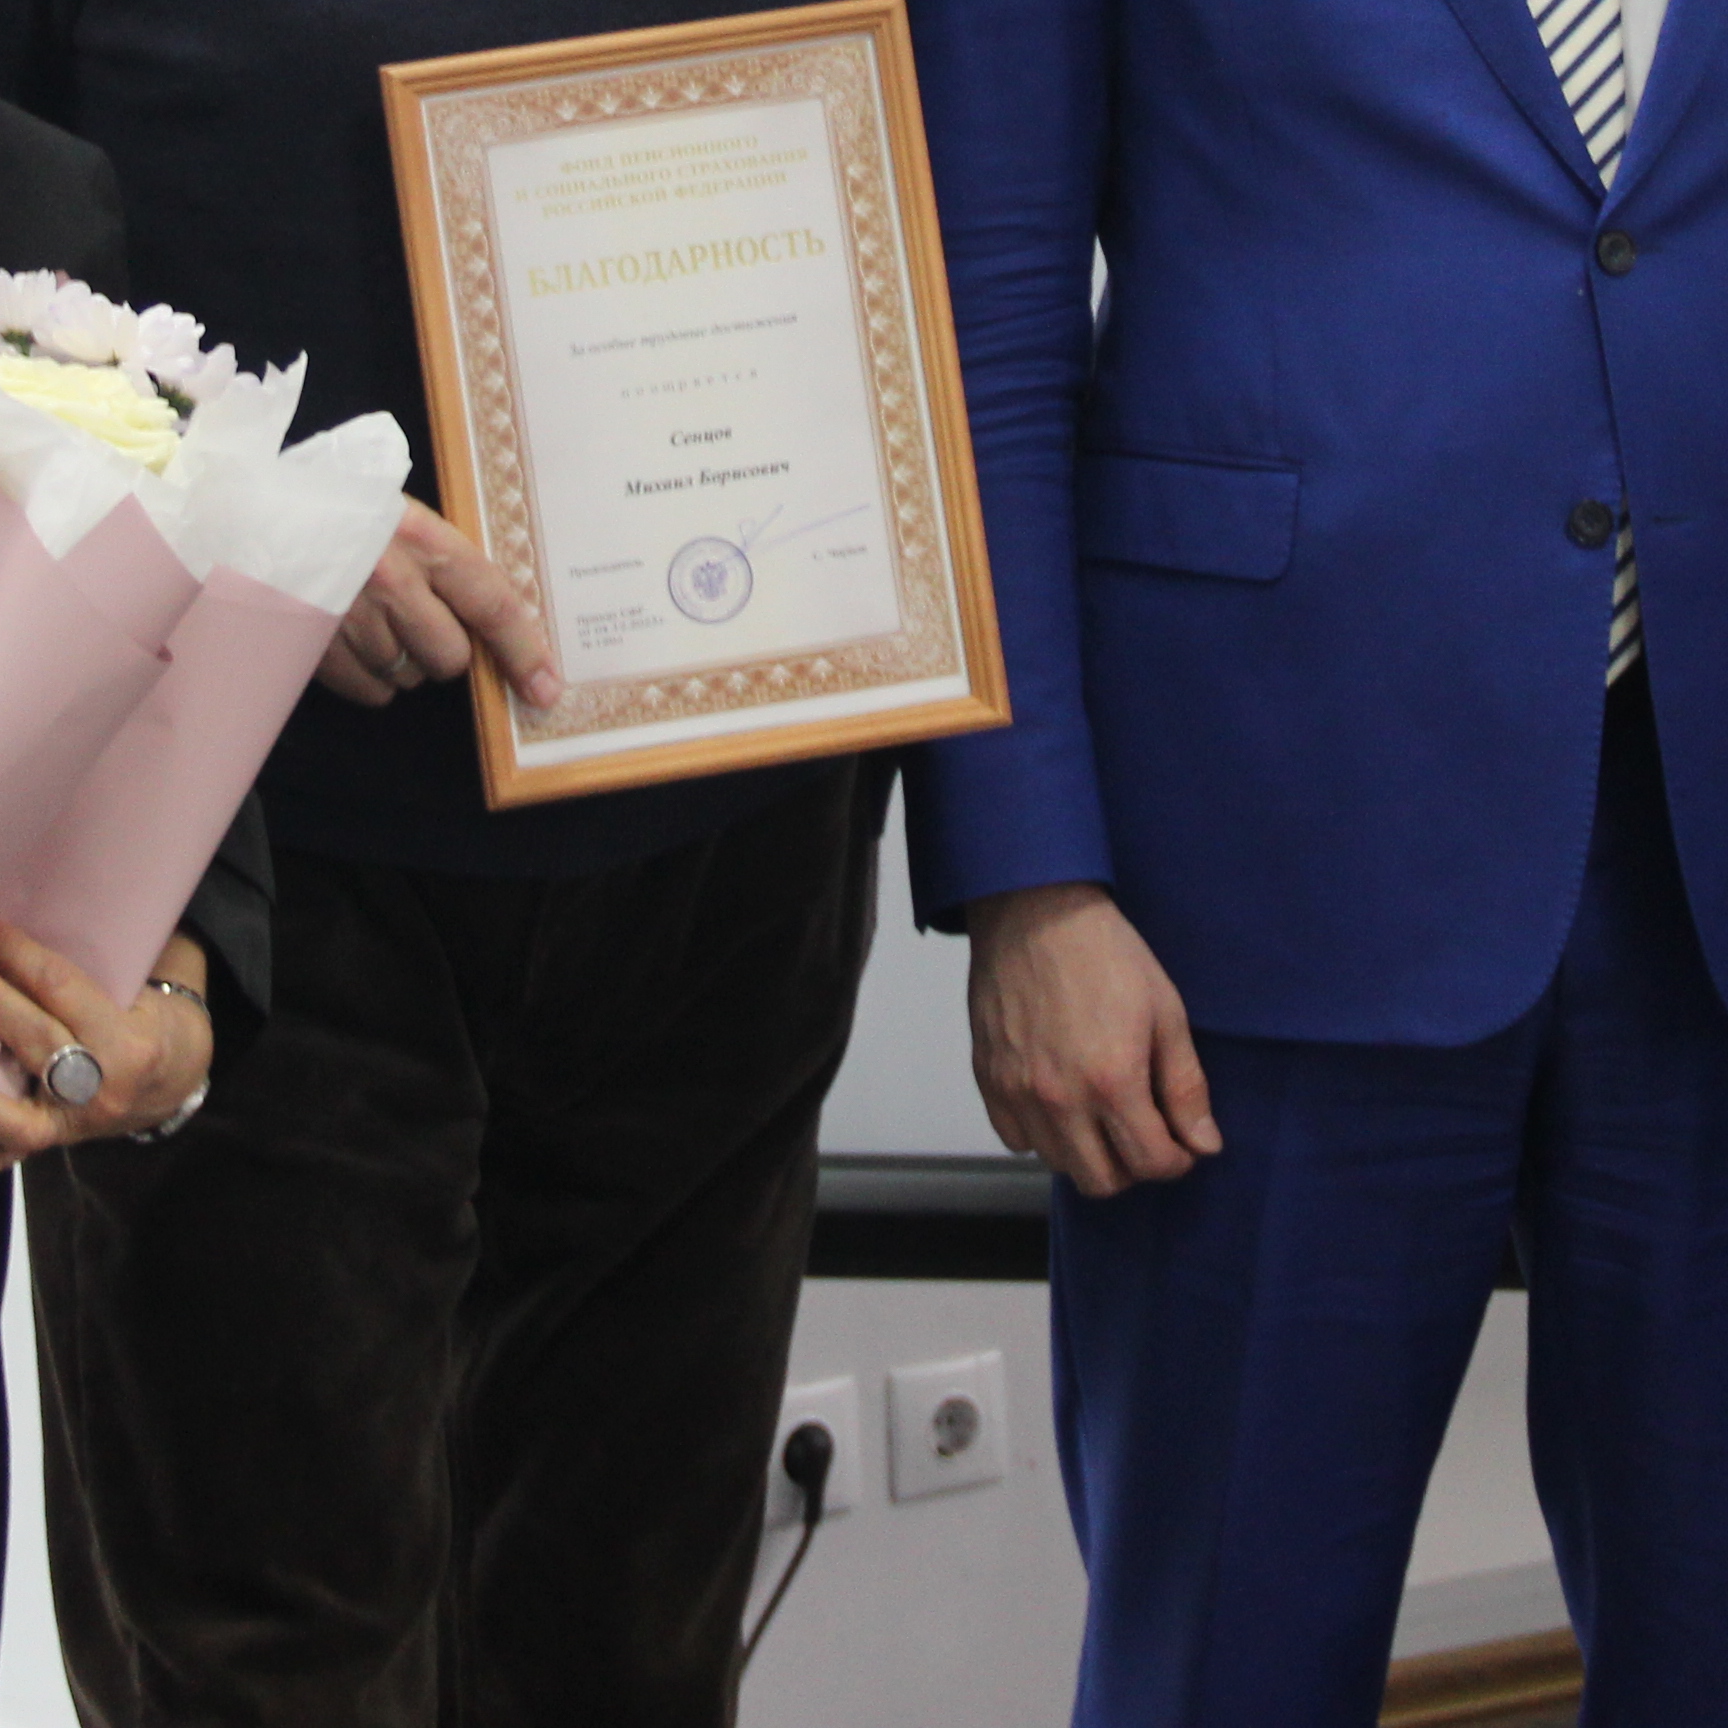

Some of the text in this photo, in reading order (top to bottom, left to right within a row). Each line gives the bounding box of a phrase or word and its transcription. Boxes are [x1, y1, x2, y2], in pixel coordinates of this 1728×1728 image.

[525, 226, 827, 299] БЛАГОДАРНОСТЬ
[669, 427, 733, 449] Сенцов
[624, 459, 791, 498] Михаил Борисович
